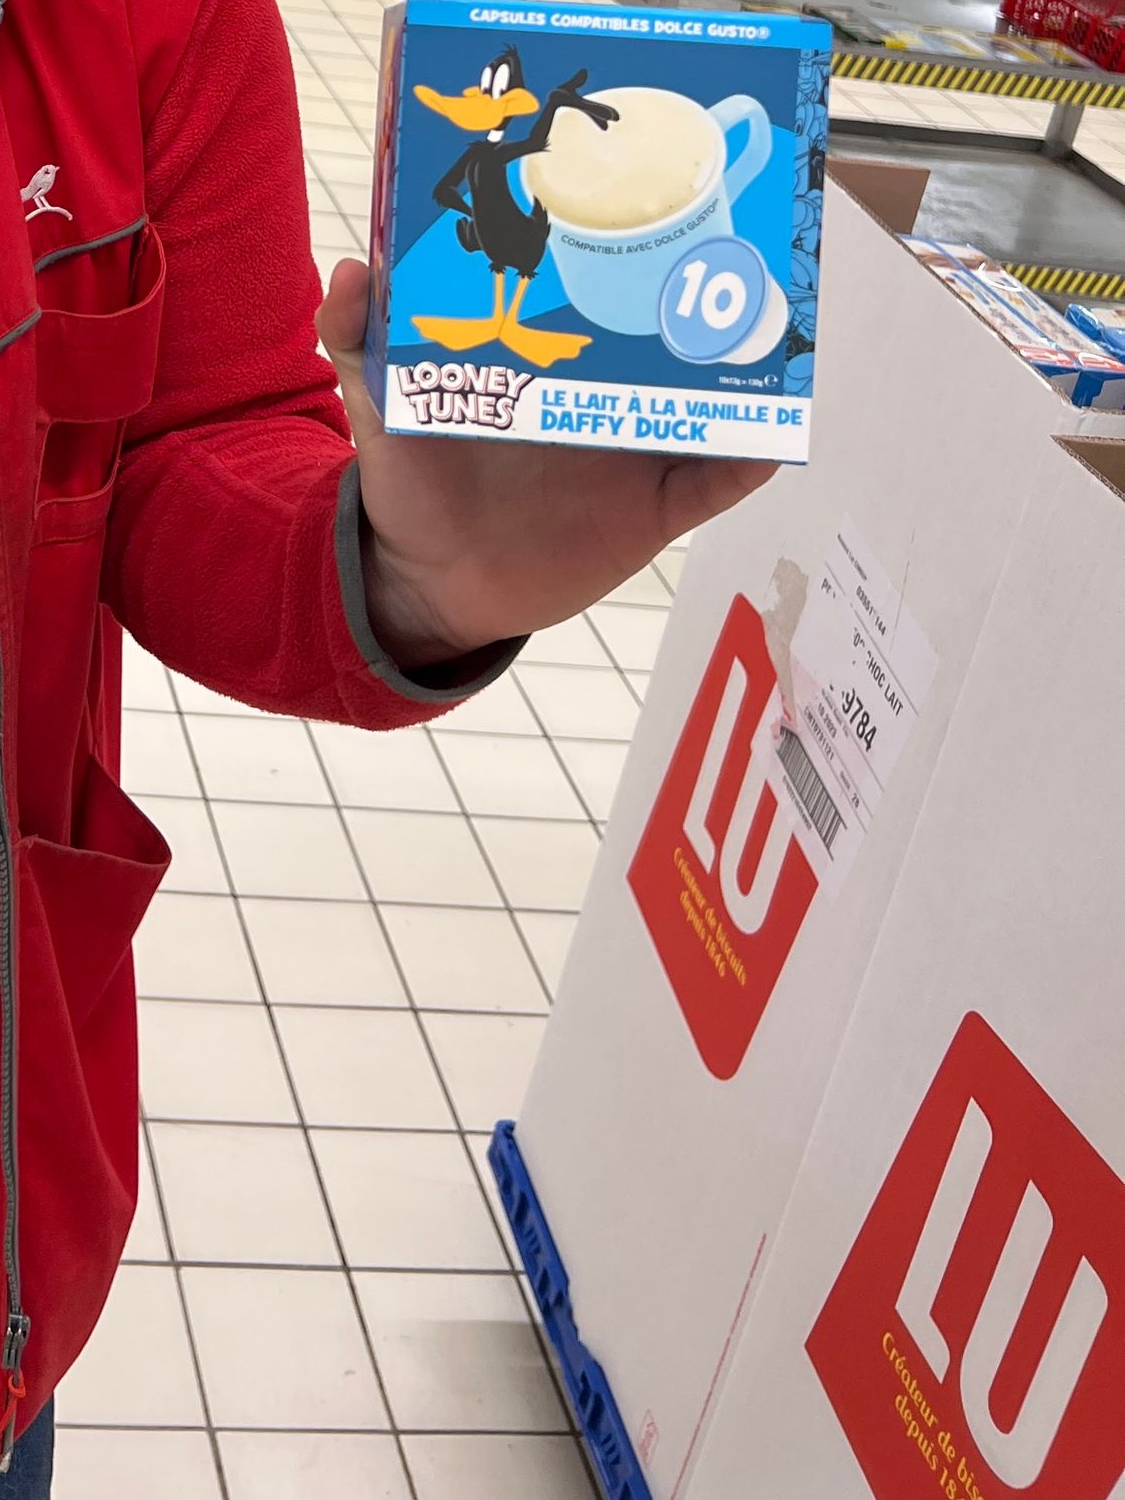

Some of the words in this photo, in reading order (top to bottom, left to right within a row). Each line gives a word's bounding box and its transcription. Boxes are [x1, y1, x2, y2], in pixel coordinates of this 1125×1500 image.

[469, 8, 546, 27] CAPSULES
[550, 13, 650, 33] COMPATIBLES
[654, 19, 703, 36] DOLCE
[560, 234, 623, 255] COMPATIBLE
[625, 242, 653, 254] AVEC
[654, 227, 686, 248] DOLCE
[674, 258, 746, 330] 10
[396, 360, 535, 398] LOONEY
[409, 393, 516, 429] TUNES
[541, 388, 567, 407] LE
[573, 392, 620, 413] LAIT
[627, 391, 642, 414] À
[649, 397, 676, 417] LA
[684, 400, 770, 424] VANILLE
[776, 407, 804, 426] DE
[540, 408, 624, 436] DAFFY
[635, 416, 708, 442] DUCK
[841, 688, 877, 752] 9784
[884, 683, 904, 717] LAIT
[682, 655, 796, 935] LU
[674, 847, 706, 909] Créateur
[705, 907, 716, 929] de
[716, 921, 747, 987] biscuits
[680, 890, 706, 940] depuis
[705, 934, 726, 977] 1846
[895, 1096, 1109, 1490] LU
[882, 1332, 938, 1428] Créateur
[938, 1431, 956, 1463] de
[895, 1394, 938, 1471] depuis
[939, 1466, 965, 1500] 18
